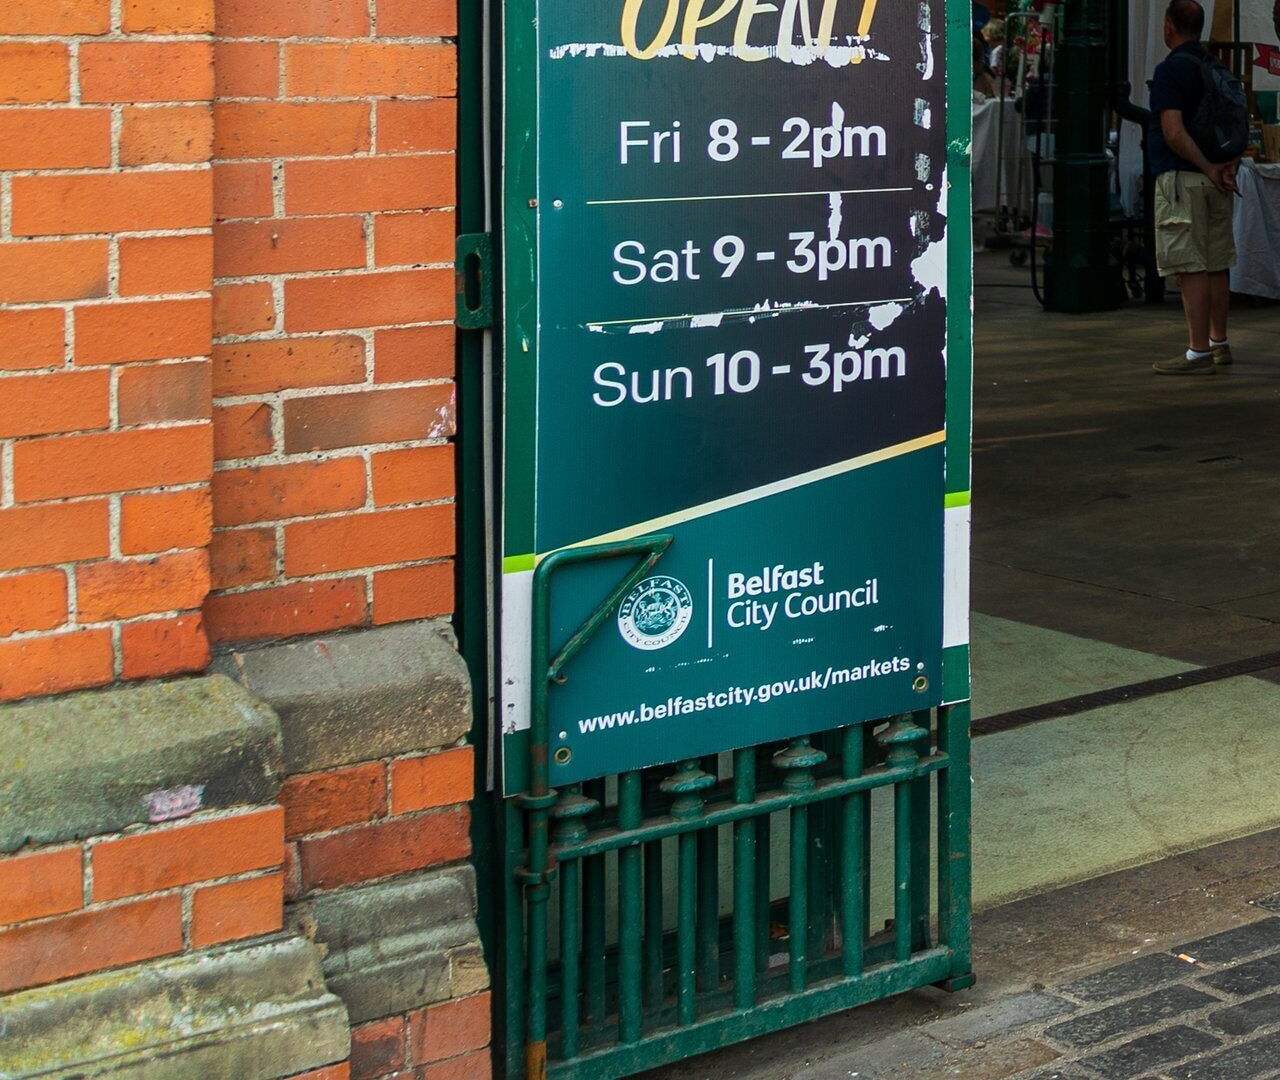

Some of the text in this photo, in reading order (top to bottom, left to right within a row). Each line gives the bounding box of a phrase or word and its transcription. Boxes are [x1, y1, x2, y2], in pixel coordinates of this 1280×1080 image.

[619, 120, 682, 165] Fri
[707, 118, 739, 162] 8
[781, 116, 888, 168] 2pm
[612, 240, 701, 287] Sat
[712, 235, 746, 279] 9
[786, 231, 893, 281] 3pm
[592, 362, 693, 408] Sun
[704, 349, 760, 395] 10
[802, 343, 907, 393] 3pm
[622, 579, 689, 615] BELFAST
[727, 559, 824, 600] Belfast
[727, 577, 880, 632] City Council
[578, 654, 911, 735] www.belfastcity.gov.uk/markets
